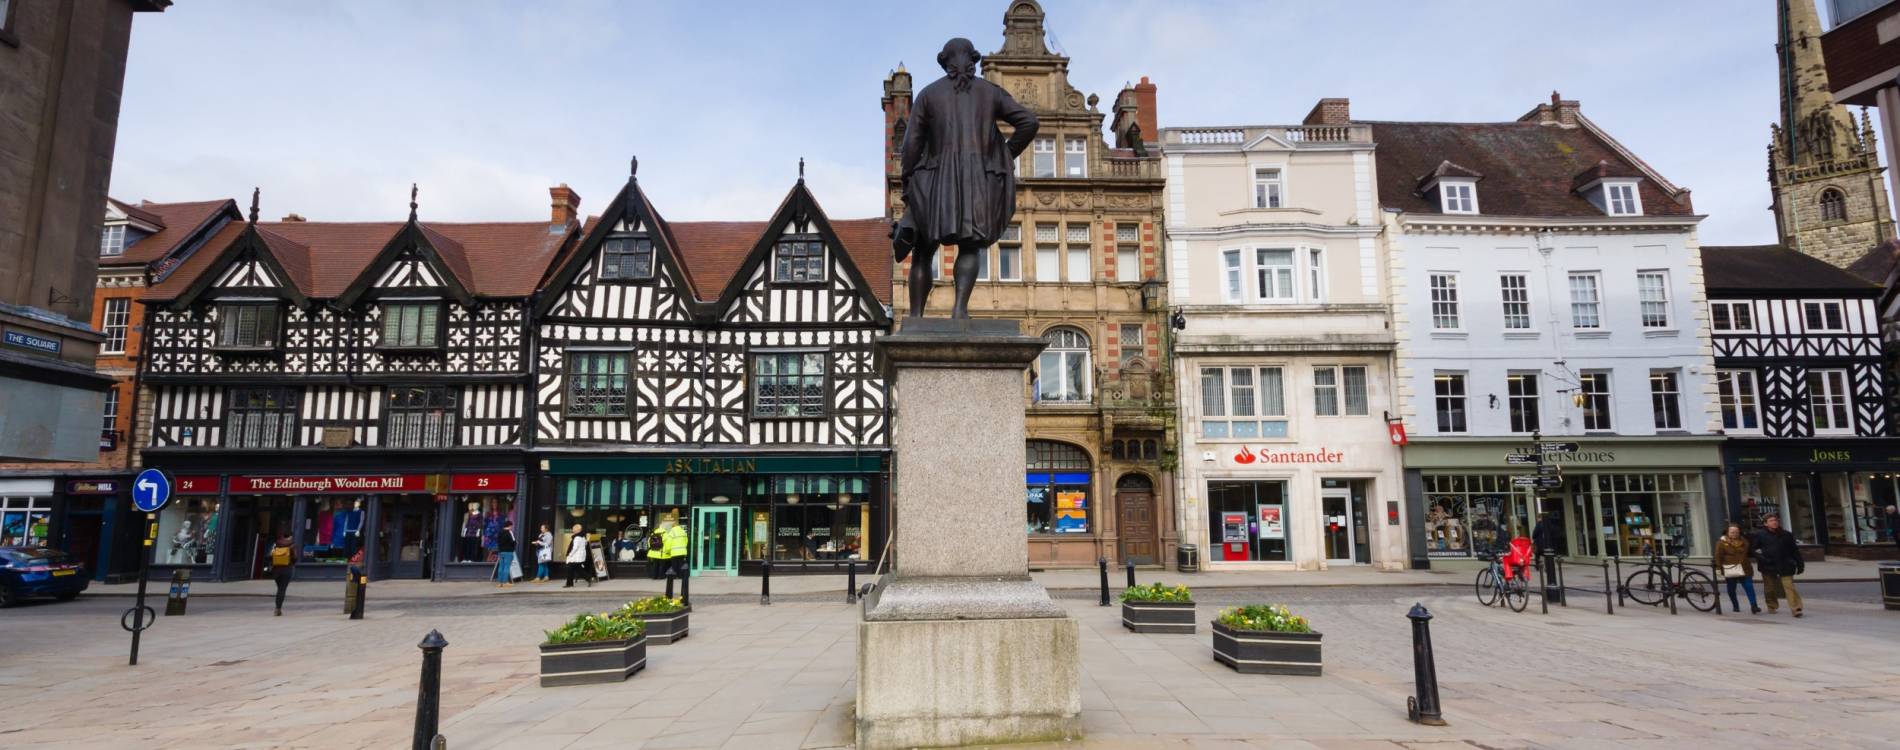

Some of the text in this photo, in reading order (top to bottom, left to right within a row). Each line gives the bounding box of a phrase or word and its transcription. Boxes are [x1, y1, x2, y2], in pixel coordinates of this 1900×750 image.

[8, 332, 57, 351] THE SQUARE
[1260, 447, 1344, 464] Santander
[1809, 448, 1850, 463] JONES
[665, 457, 756, 472] ASK ITALIAN
[98, 482, 113, 491] HILL
[182, 480, 193, 489] 24
[250, 477, 404, 491] The Edinburgh Woollen Mill
[477, 477, 489, 487] 25
